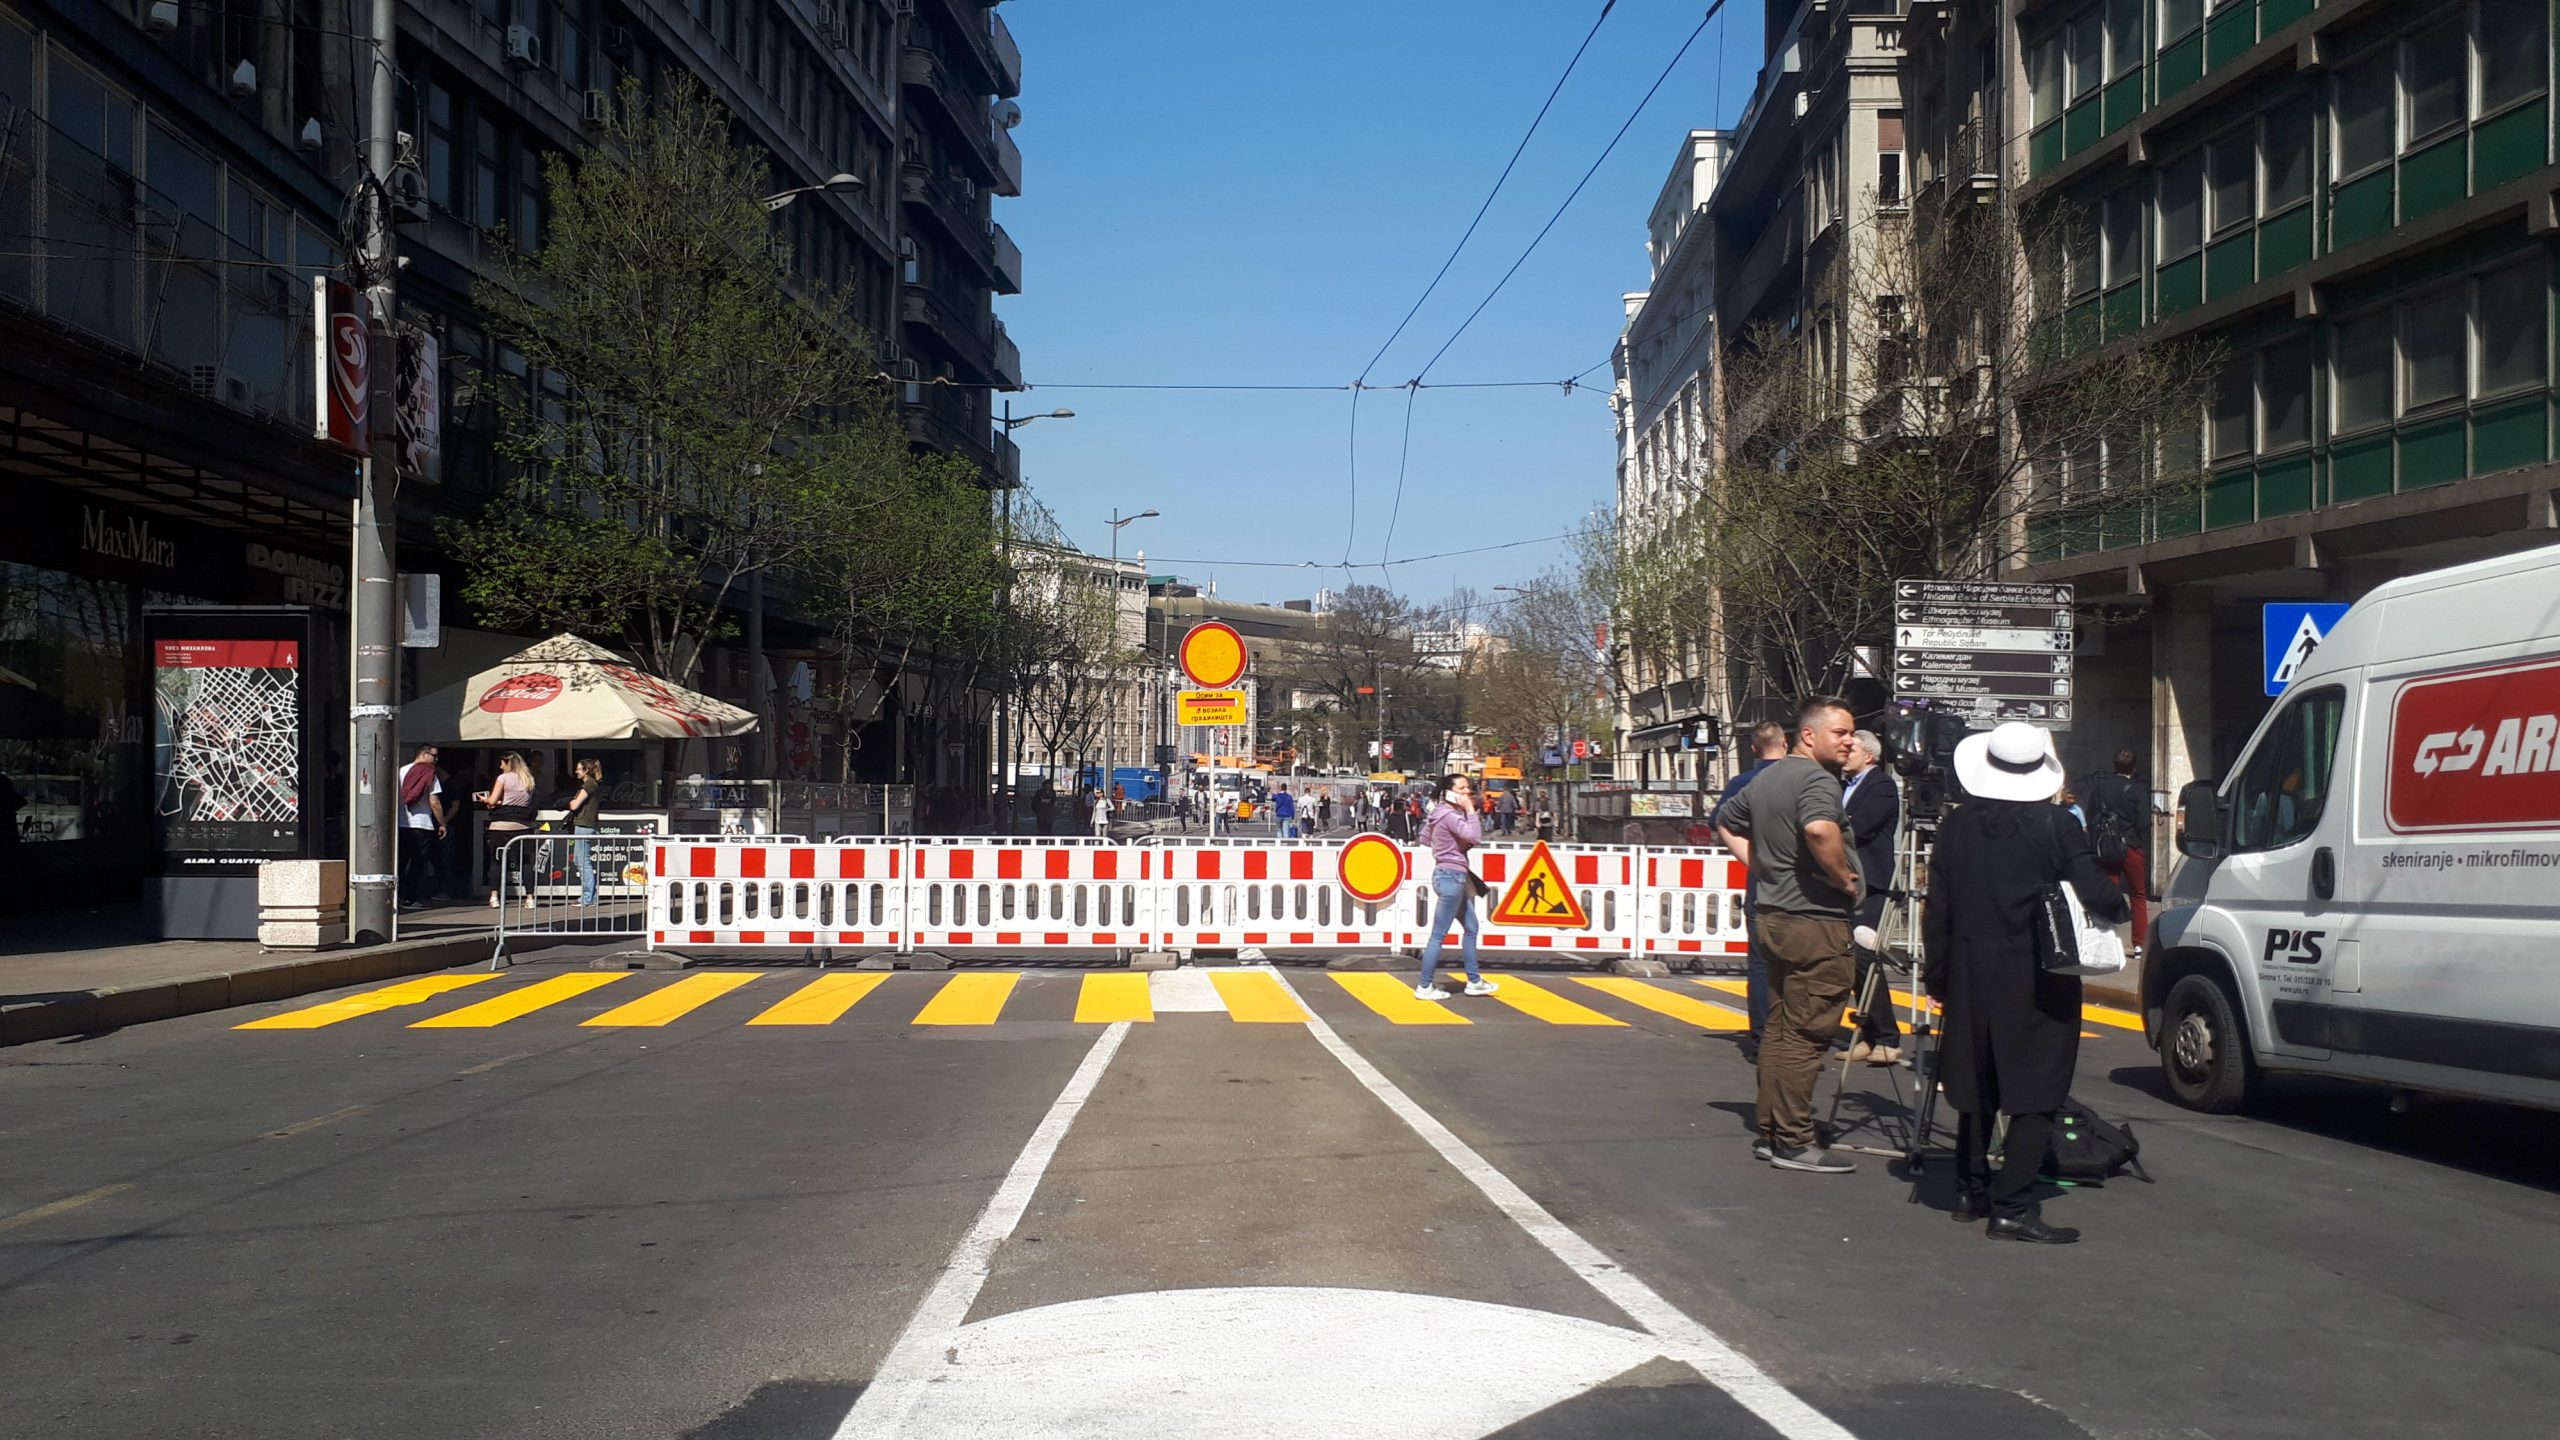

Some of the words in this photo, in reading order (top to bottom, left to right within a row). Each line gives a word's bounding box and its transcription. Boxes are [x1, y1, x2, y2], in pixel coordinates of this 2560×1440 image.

[81, 505, 175, 568] MaxMara
[283, 575, 350, 610] PIZZ
[1989, 594, 2015, 603] Serbia
[1922, 638, 1957, 649] Republic
[1958, 639, 1988, 649] Square
[1921, 651, 1973, 662] Калемегдан
[1921, 660, 1972, 671] Kalemegdan
[1920, 675, 1957, 686] Народни
[1955, 685, 1991, 695] Museum
[2381, 851, 2454, 872] skeniranje
[2466, 849, 2560, 867] mikrofilmov
